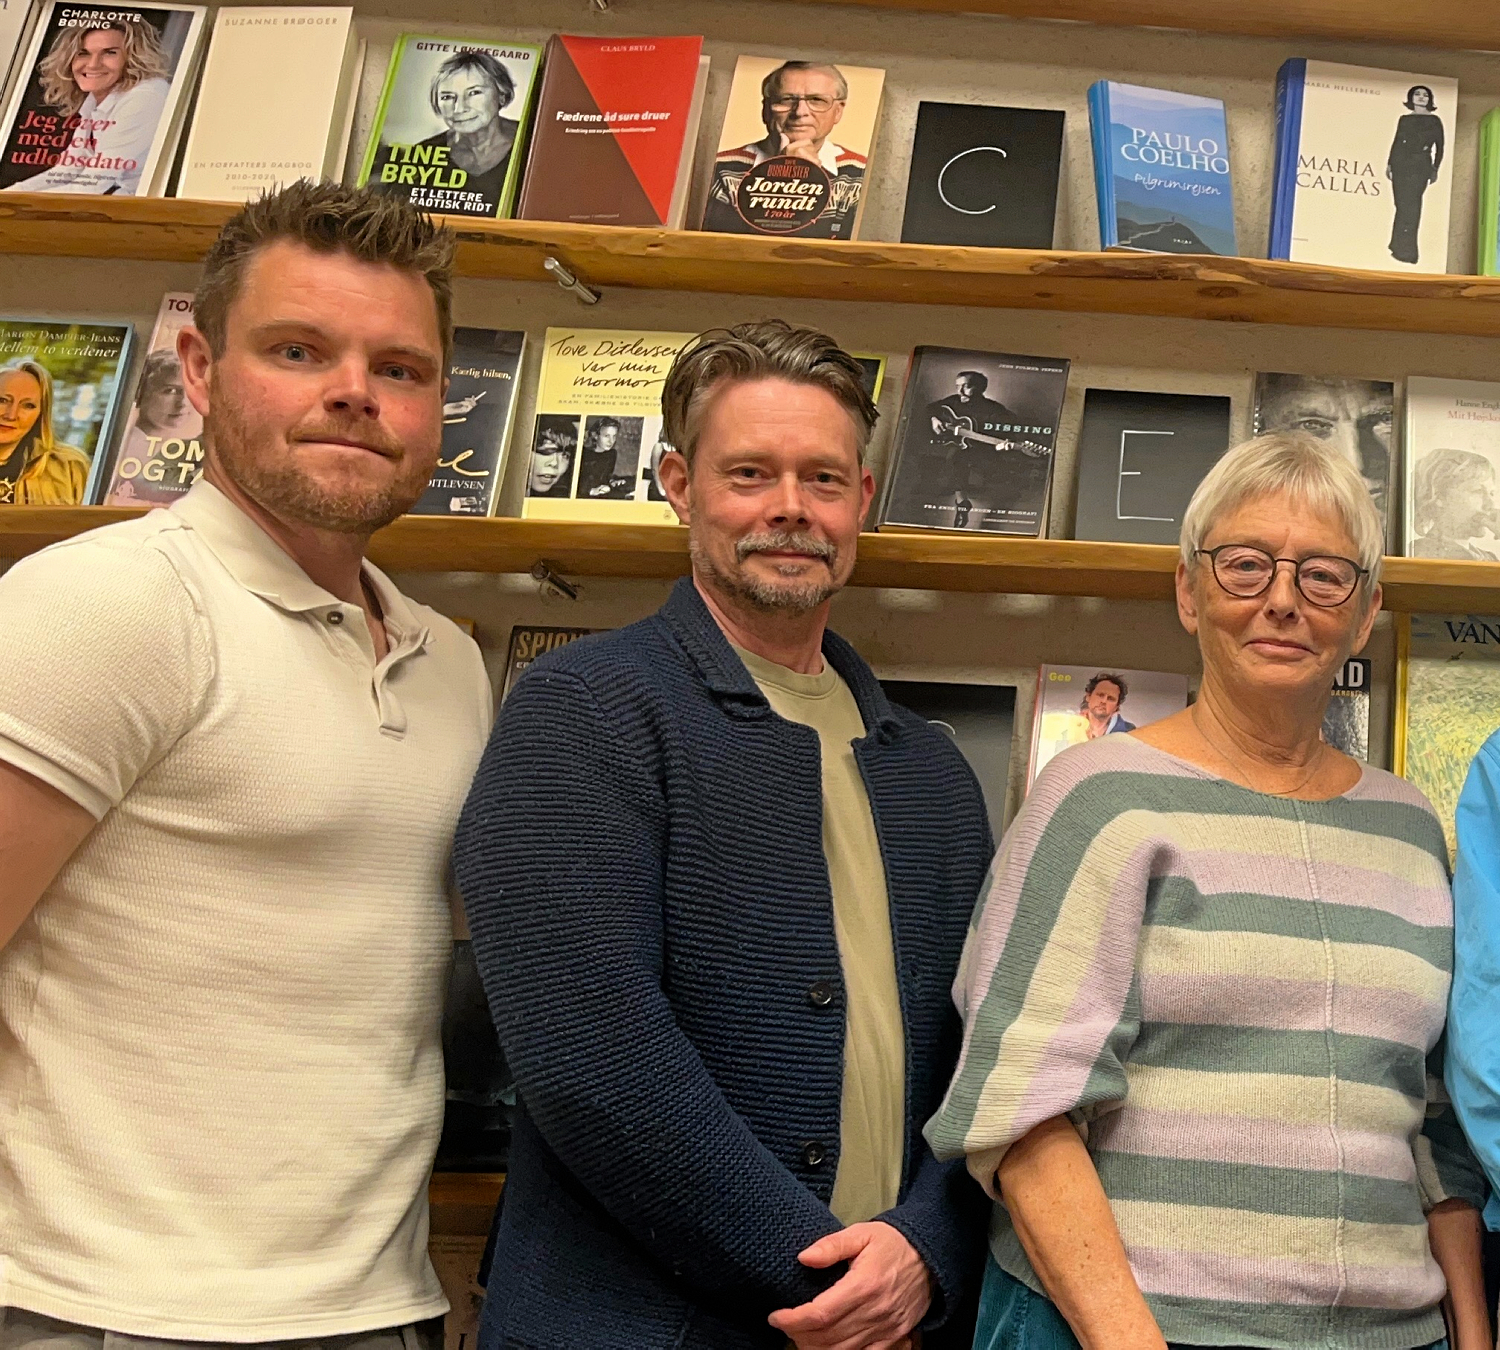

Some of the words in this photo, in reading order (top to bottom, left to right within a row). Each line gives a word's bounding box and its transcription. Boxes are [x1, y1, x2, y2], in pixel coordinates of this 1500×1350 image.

[58, 18, 111, 29] BØVING
[61, 9, 141, 22] CHARLOTTE
[225, 17, 278, 26] SUZANNE
[284, 17, 338, 25] BRØGGER
[417, 42, 450, 52] GITTE
[453, 44, 530, 60] LØKKEGAARD
[1334, 84, 1381, 96] HELLEBERG
[19, 110, 60, 133] Jeg
[556, 111, 602, 122] Fædrene
[603, 111, 617, 122] åd
[618, 112, 641, 122] sure
[641, 111, 671, 121] druer
[17, 132, 68, 148] med
[71, 136, 98, 150] en
[1132, 128, 1218, 156] PAULO
[11, 148, 137, 171] udløbsdato
[388, 142, 451, 166] TINE
[1121, 143, 1230, 175] COELHO
[1298, 154, 1376, 178] MARIA
[380, 163, 467, 189] BRYLD
[938, 146, 1007, 215] C
[1296, 172, 1381, 197] CALLAS
[746, 177, 824, 196] Jorden
[1134, 173, 1222, 197] Pilgrimsrejsen
[411, 187, 425, 198] ET
[429, 190, 483, 203] LETTERE
[749, 195, 818, 211] rundt
[409, 197, 460, 210] KAOTISK
[463, 201, 493, 213] RIDT
[769, 210, 781, 218] 70
[783, 210, 795, 219] år
[43, 343, 56, 355] to
[61, 345, 119, 358] verdener
[550, 335, 588, 357] Tove
[451, 366, 481, 379] Kærlig
[482, 368, 512, 381] hilsen,
[582, 361, 616, 373] var
[618, 360, 662, 375] min
[573, 375, 668, 389] mormor
[1455, 399, 1481, 408] Hanne
[1447, 410, 1466, 420] Mit
[984, 422, 1052, 435] DISSING
[118, 457, 166, 482] OG
[1117, 430, 1175, 522] E
